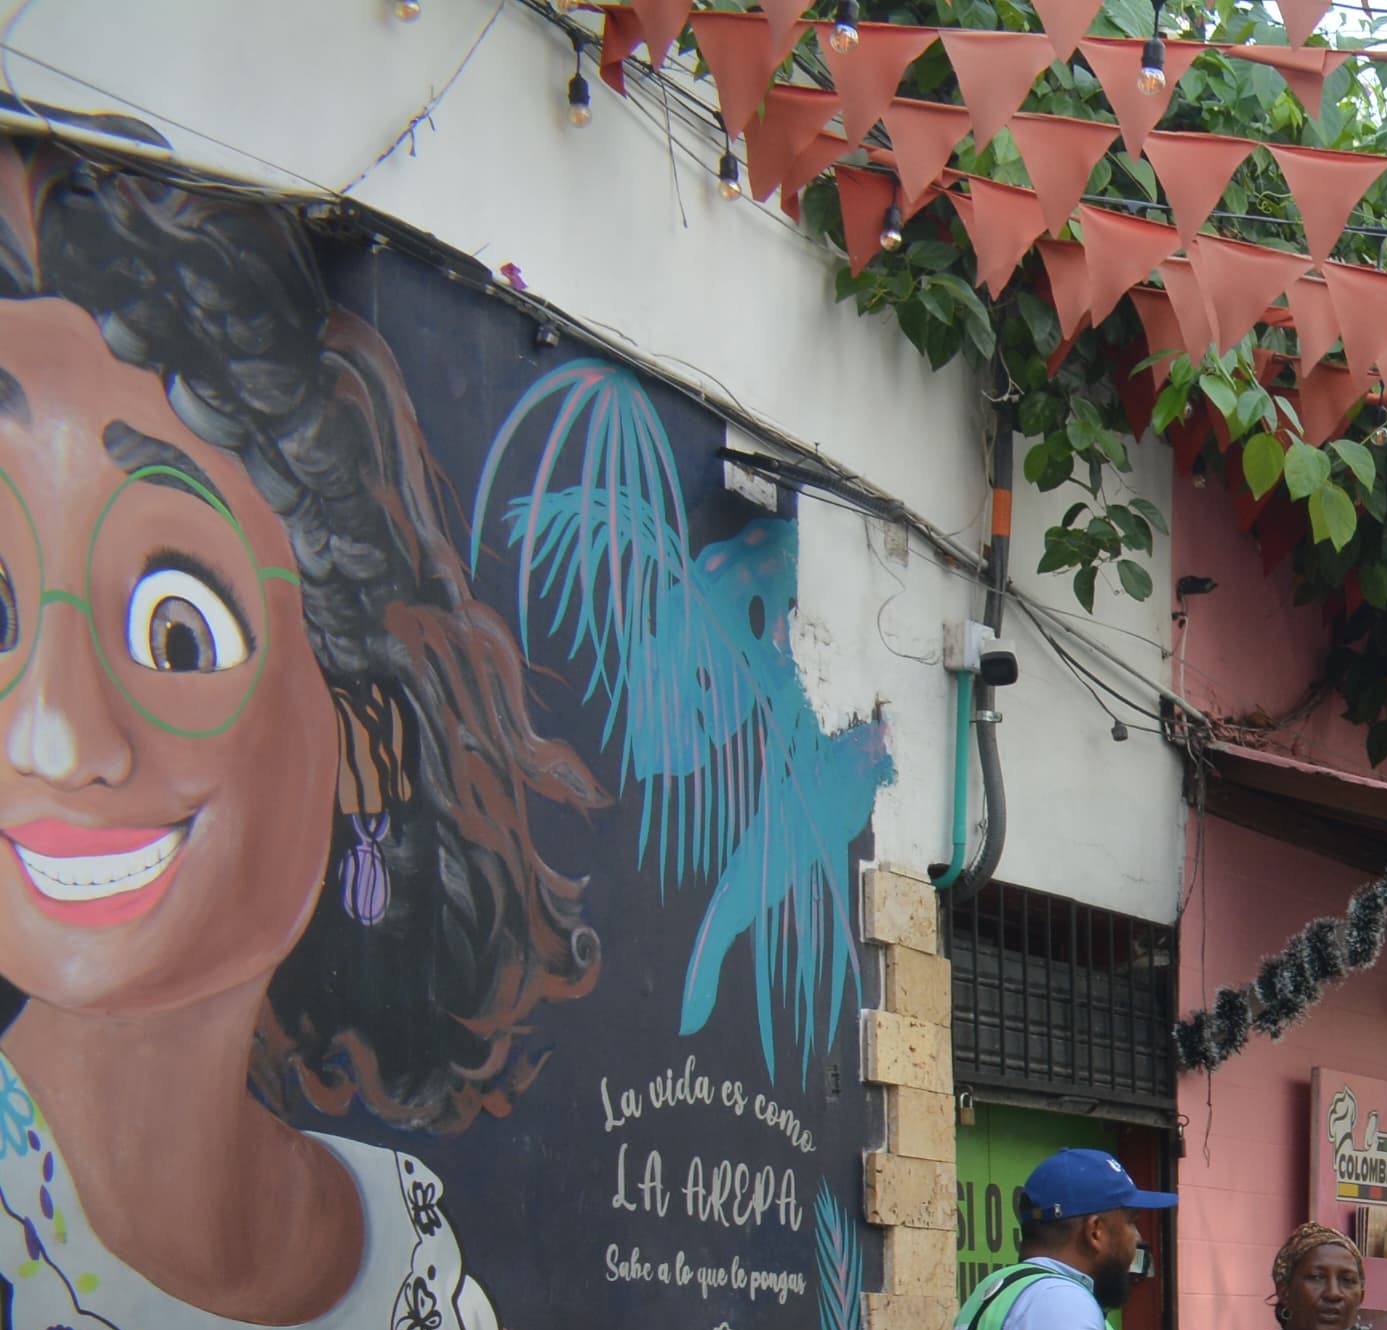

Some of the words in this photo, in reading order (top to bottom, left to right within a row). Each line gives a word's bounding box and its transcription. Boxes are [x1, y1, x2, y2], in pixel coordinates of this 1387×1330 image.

[600, 1077, 642, 1132] La
[649, 1055, 714, 1109] vida
[721, 1080, 748, 1116] es
[754, 1094, 816, 1152] como
[612, 1143, 670, 1217] LA
[682, 1156, 803, 1231] AREPA
[658, 1262, 671, 1284] a
[675, 1250, 693, 1286] lo
[697, 1266, 728, 1300] que
[731, 1255, 748, 1289] le
[750, 1269, 807, 1304] pongas
